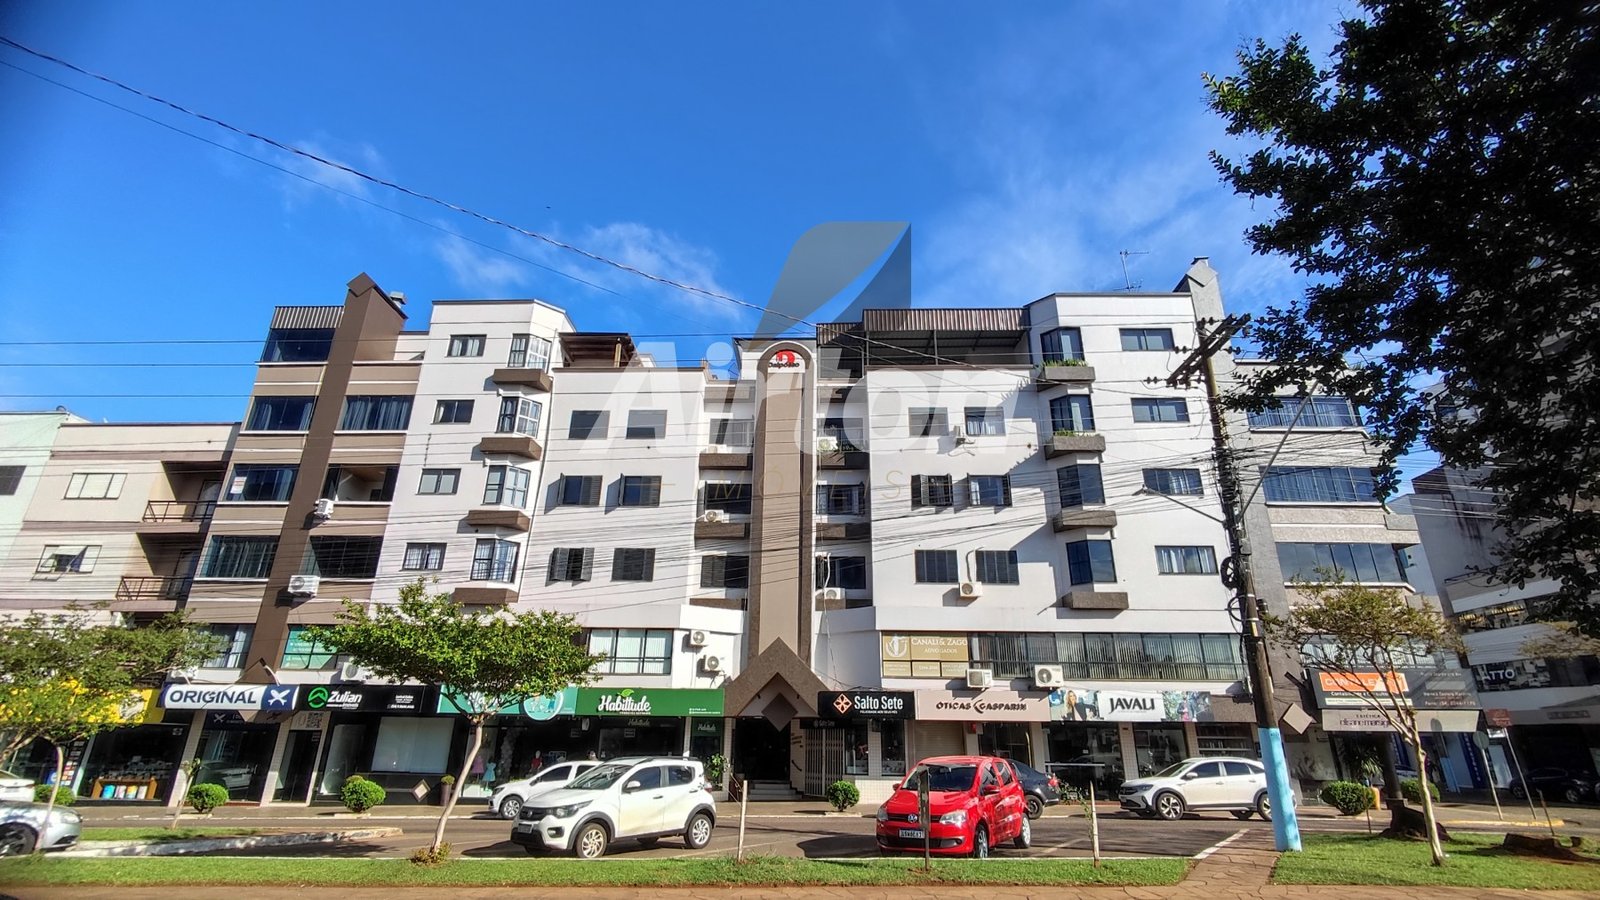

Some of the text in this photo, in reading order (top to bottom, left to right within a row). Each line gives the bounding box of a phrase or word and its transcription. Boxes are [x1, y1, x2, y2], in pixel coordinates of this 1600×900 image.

[947, 638, 968, 646] ZAGO
[170, 690, 257, 704] ORIGINAL
[327, 691, 363, 703] Zulian
[597, 695, 652, 712] Habittude
[854, 695, 903, 710] Salto Sete
[1109, 697, 1155, 714] JAVALI
